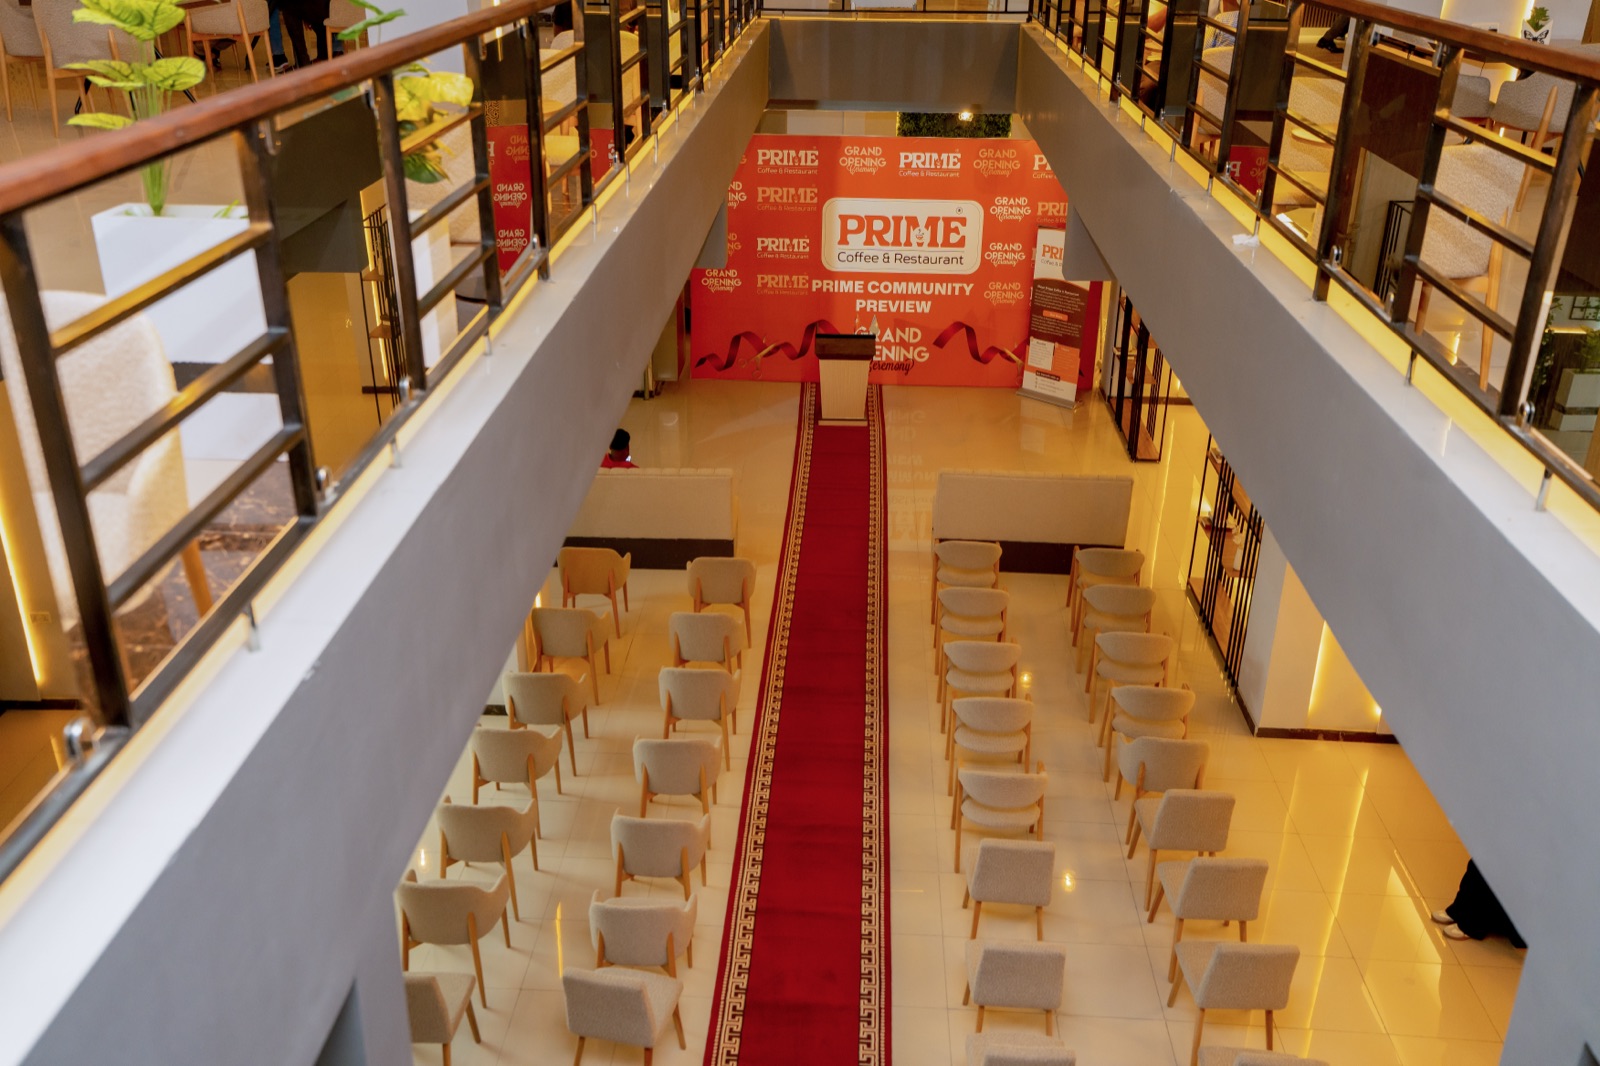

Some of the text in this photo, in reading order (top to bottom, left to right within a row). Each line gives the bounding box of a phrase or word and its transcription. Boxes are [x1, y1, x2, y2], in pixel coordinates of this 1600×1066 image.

[844, 146, 882, 156] GRAND
[979, 148, 1017, 159] GRAND
[757, 149, 819, 166] PRIME
[839, 157, 887, 168] OPENING
[899, 152, 961, 169] PRIME
[973, 159, 1021, 170] OPENING
[757, 187, 818, 203] PRIME
[994, 196, 1028, 206] GRAND
[989, 206, 1032, 215] OPENING
[1037, 202, 1068, 216] PRI
[837, 214, 967, 248] PRIME
[757, 238, 810, 252] PRIME
[989, 242, 1022, 251] GRAND
[984, 251, 1026, 260] OPENING
[1042, 244, 1063, 260] PRI
[837, 252, 964, 266] Coffee & Restaurant
[705, 269, 738, 277] GRAND
[701, 278, 742, 287] OPENING
[757, 275, 809, 288] PRIME
[812, 279, 974, 296] PRIME COMMUNITY
[988, 281, 1021, 290] GRAND
[983, 290, 1025, 300] OPENING
[856, 299, 932, 313] PREVIEW
[873, 345, 929, 362] ENING
